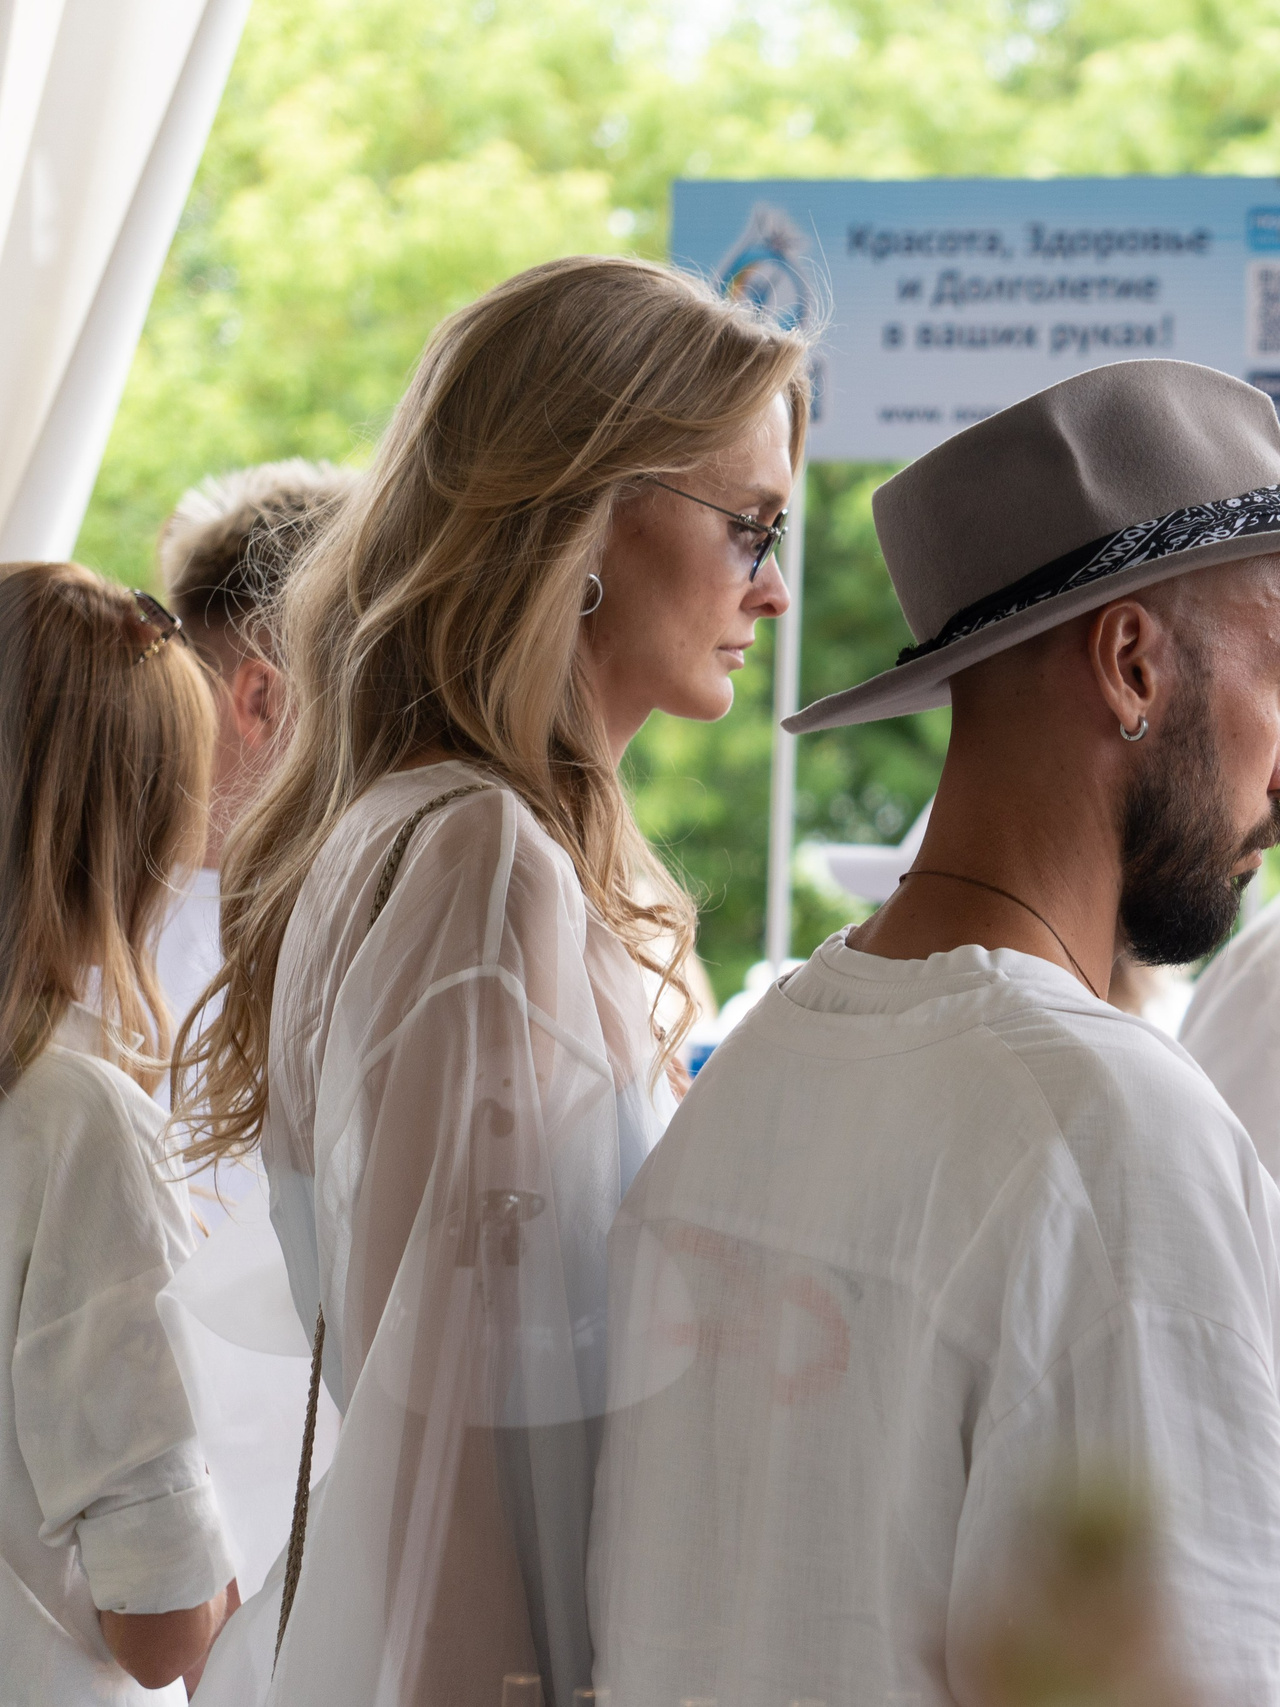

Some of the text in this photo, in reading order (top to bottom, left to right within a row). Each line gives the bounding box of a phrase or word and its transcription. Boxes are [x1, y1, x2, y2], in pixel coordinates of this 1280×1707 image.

[848, 221, 1211, 263] Красота, Здоровье
[898, 267, 1160, 309] и Долголетие
[883, 313, 1175, 355] в ваших руках!
